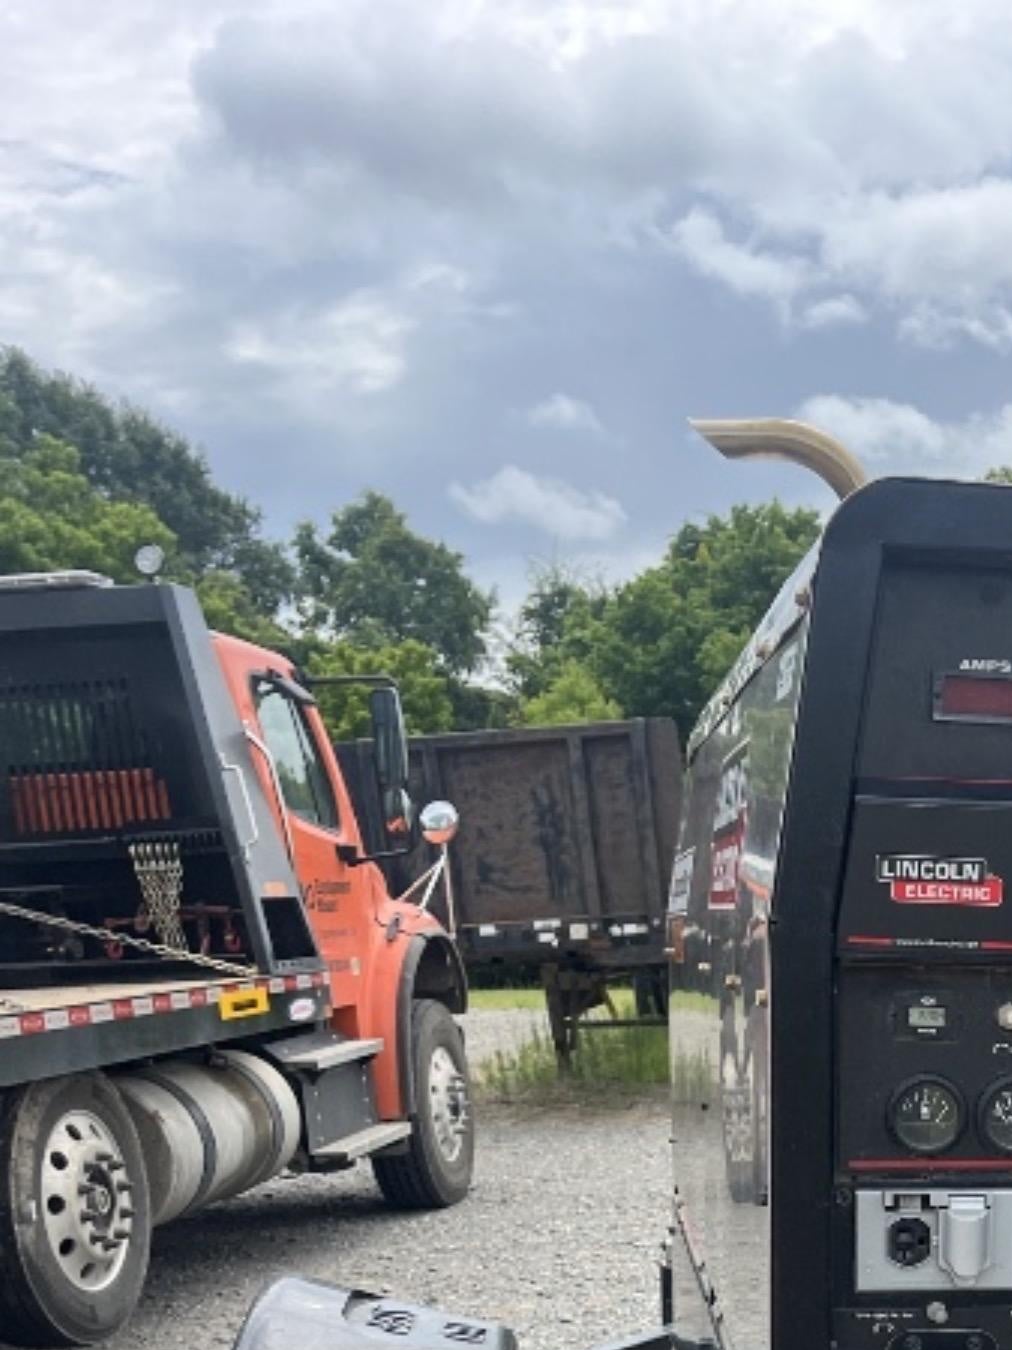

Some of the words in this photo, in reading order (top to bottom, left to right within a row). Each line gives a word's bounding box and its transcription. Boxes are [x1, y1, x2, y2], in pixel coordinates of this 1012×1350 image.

[959, 658, 1012, 673] AMPS
[881, 859, 980, 881] LINCOLN
[904, 883, 992, 901] ELECTRIC
